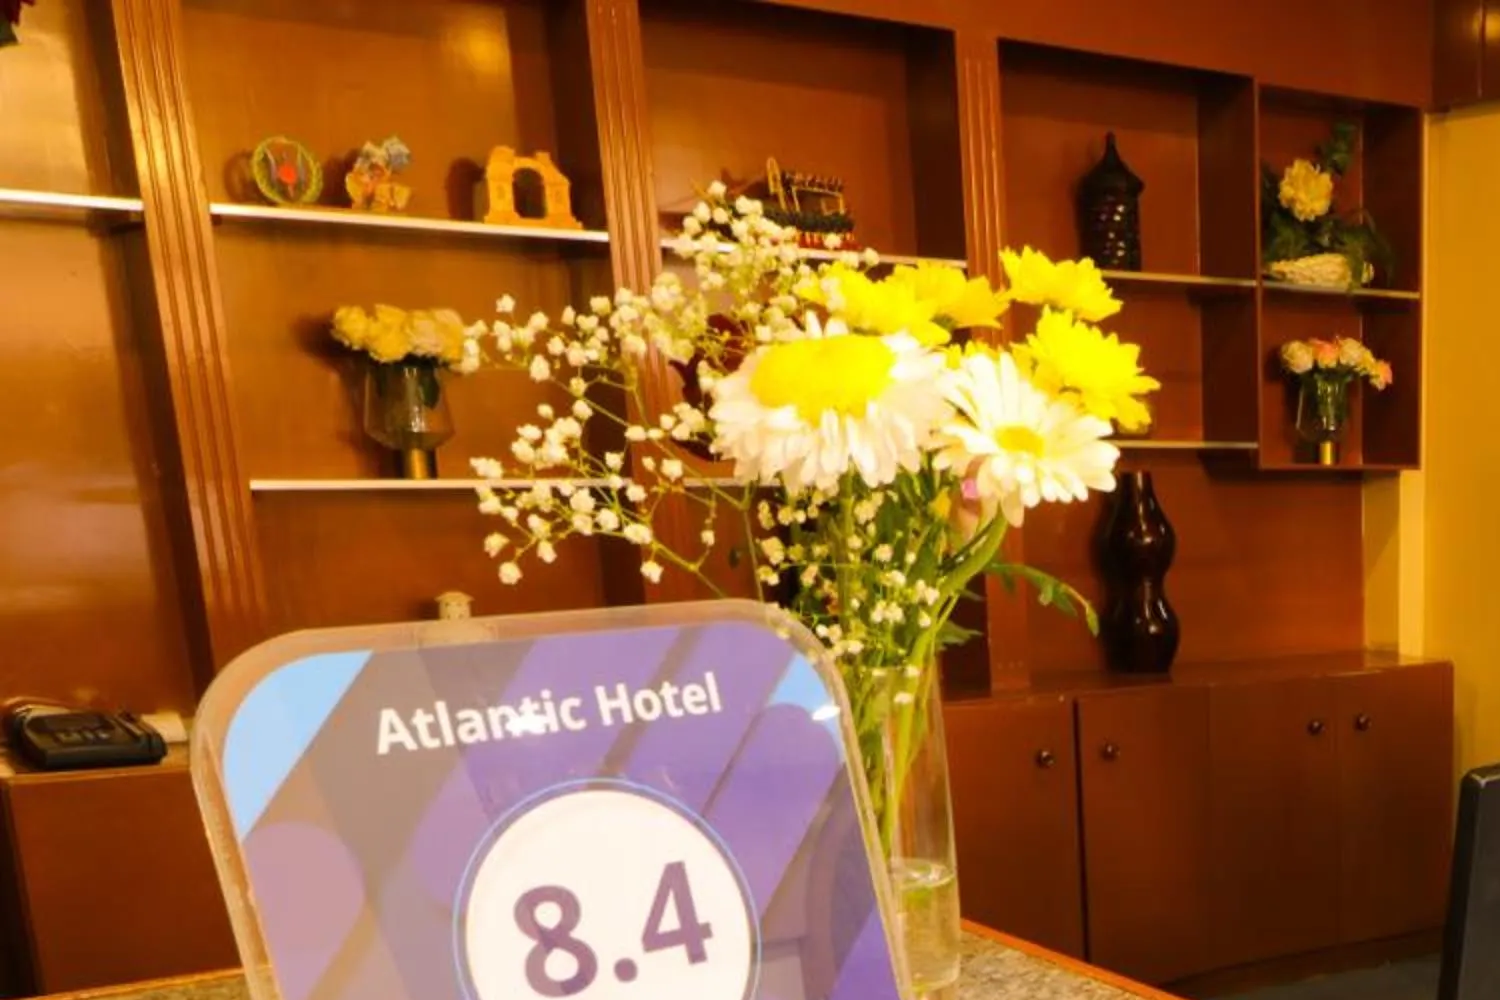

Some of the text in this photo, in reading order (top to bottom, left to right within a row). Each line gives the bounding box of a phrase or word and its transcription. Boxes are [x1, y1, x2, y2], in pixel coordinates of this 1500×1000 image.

[377, 671, 723, 755] Atlantic Hotel
[512, 860, 714, 999] 8.4
